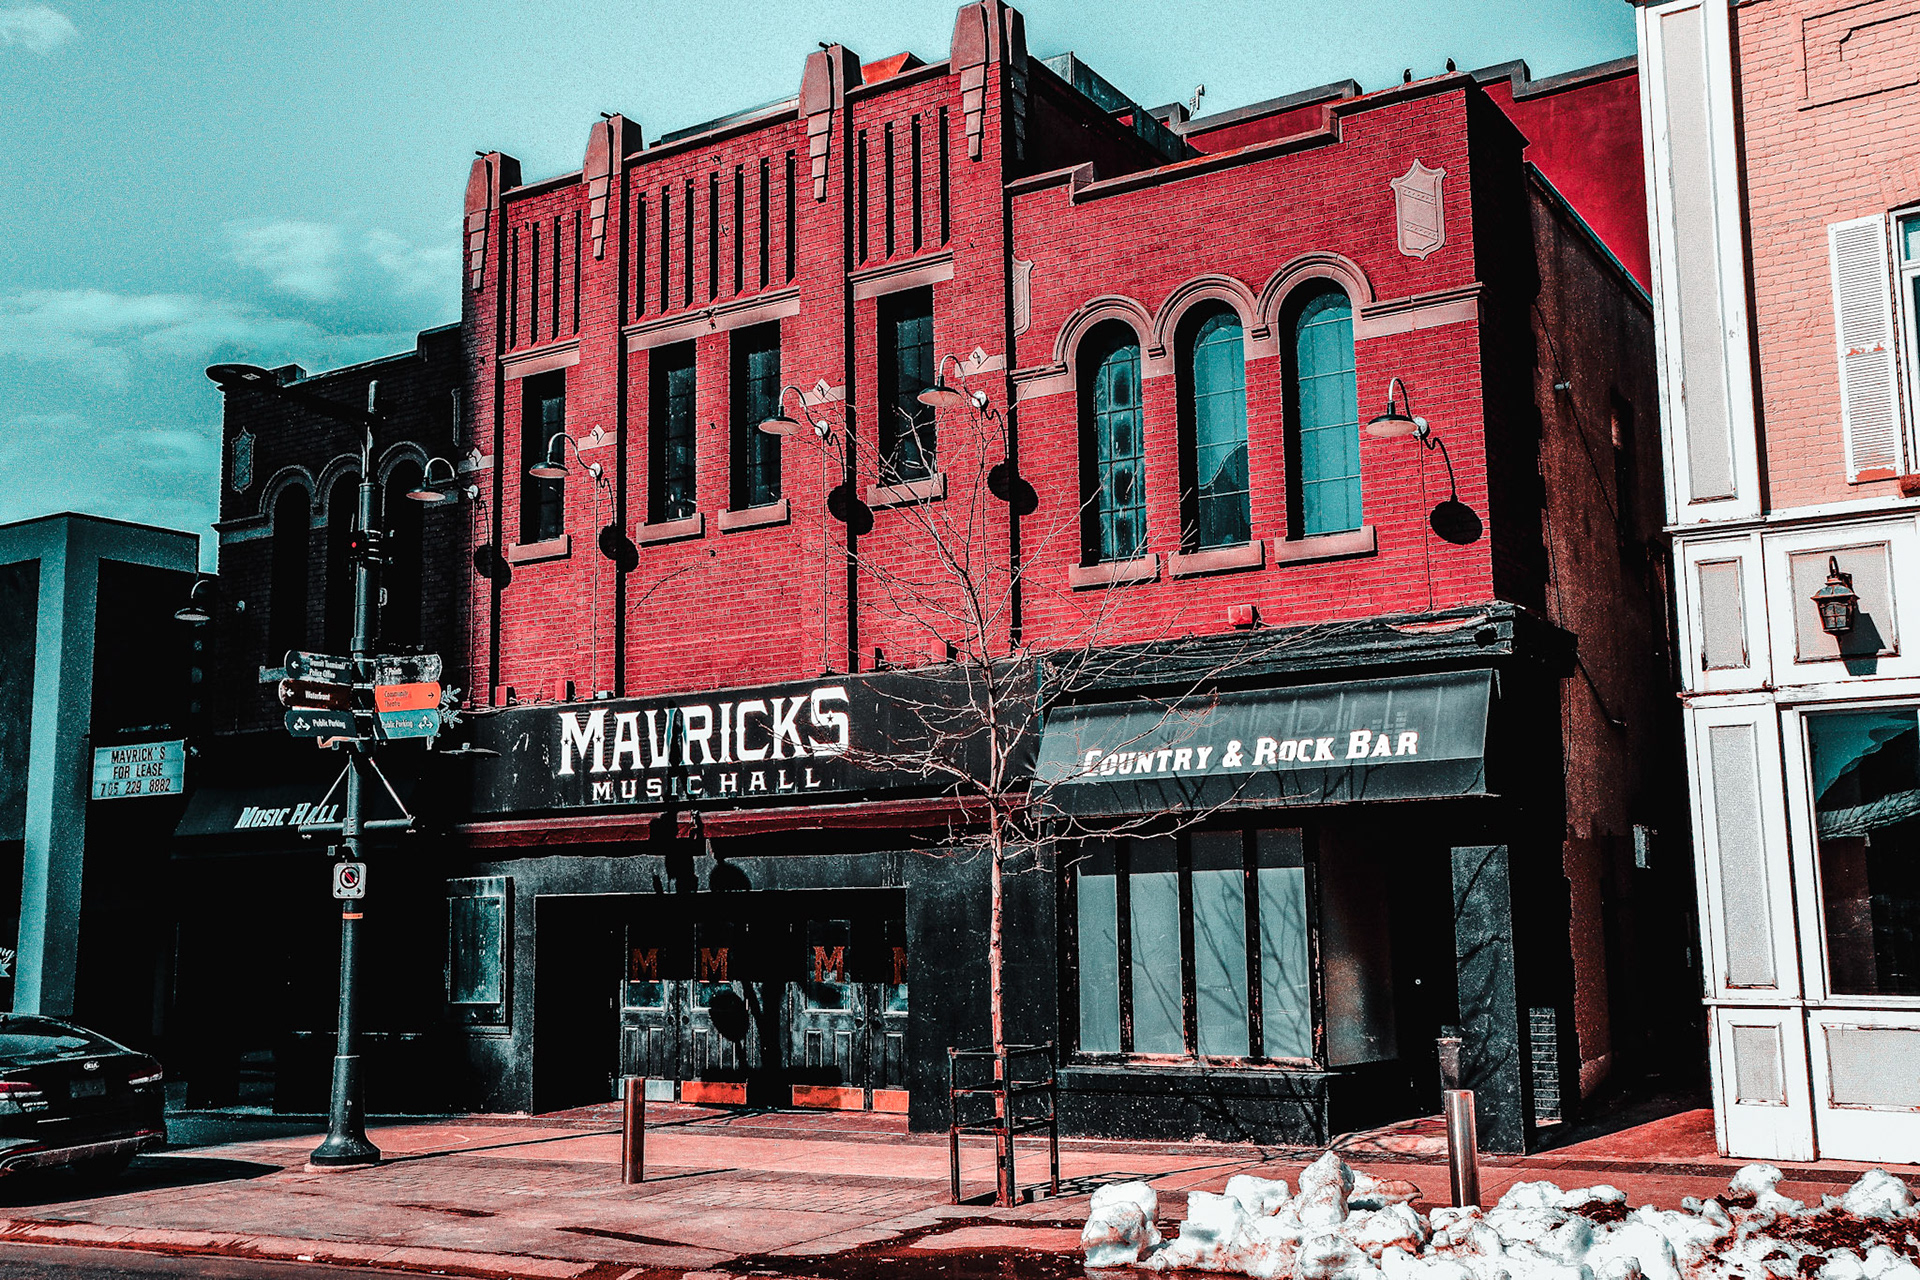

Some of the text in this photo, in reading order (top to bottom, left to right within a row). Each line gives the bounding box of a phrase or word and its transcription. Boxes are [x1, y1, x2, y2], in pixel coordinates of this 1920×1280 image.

[312, 719, 347, 730] Public Parking
[395, 719, 414, 728] Parking
[557, 686, 851, 776] MAVRICKS
[111, 746, 166, 764] MAVRICK'S
[1082, 728, 1420, 777] COUNTRY & ROCK BAR
[113, 762, 164, 780] FOR LEASE
[125, 780, 142, 795] 229
[148, 778, 171, 793] 8882
[592, 766, 821, 801] MUSIC HALL
[233, 802, 339, 829] MUSIC HALL
[630, 948, 660, 983] M
[699, 947, 730, 983] M
[813, 945, 846, 983] M
